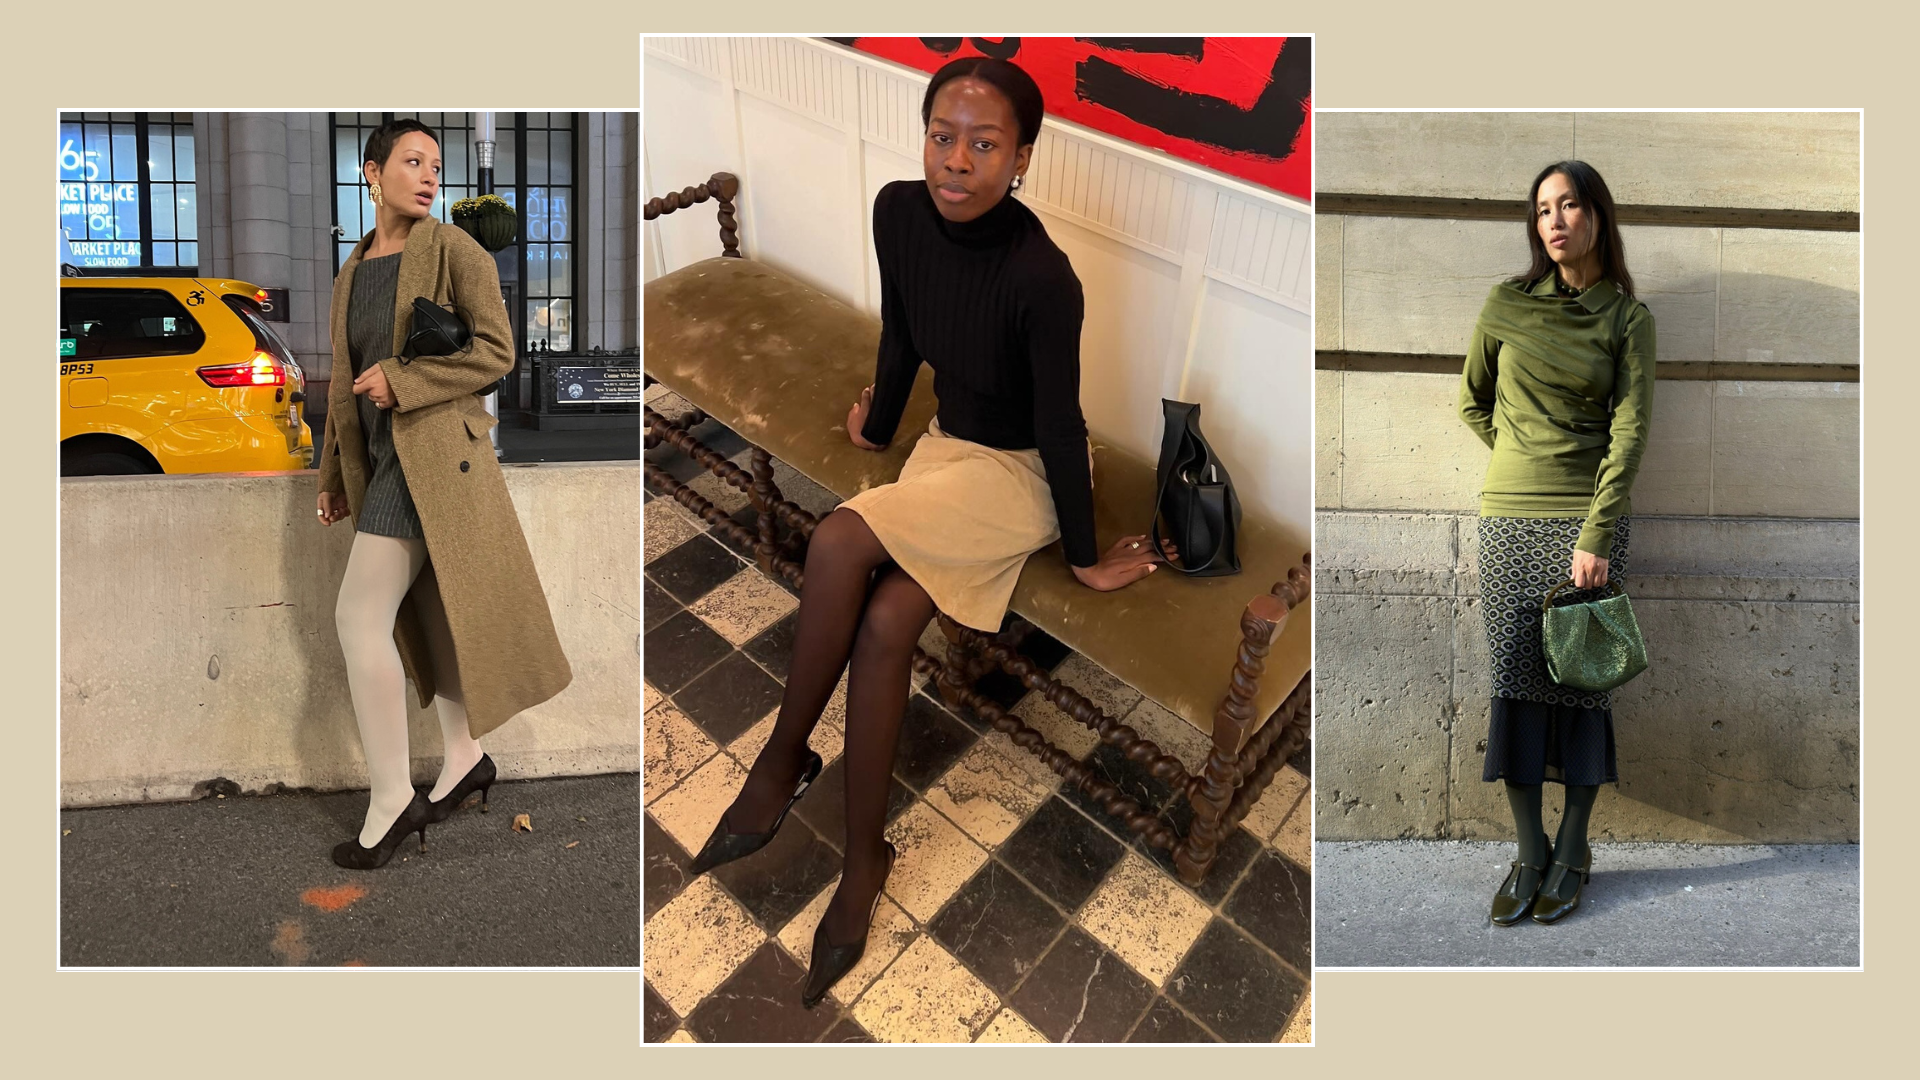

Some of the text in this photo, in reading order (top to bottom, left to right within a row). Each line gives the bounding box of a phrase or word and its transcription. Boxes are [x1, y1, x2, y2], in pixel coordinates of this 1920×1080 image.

[60, 139, 100, 182] 65
[89, 184, 135, 201] PLACE
[84, 257, 128, 266] SLOW FOOD
